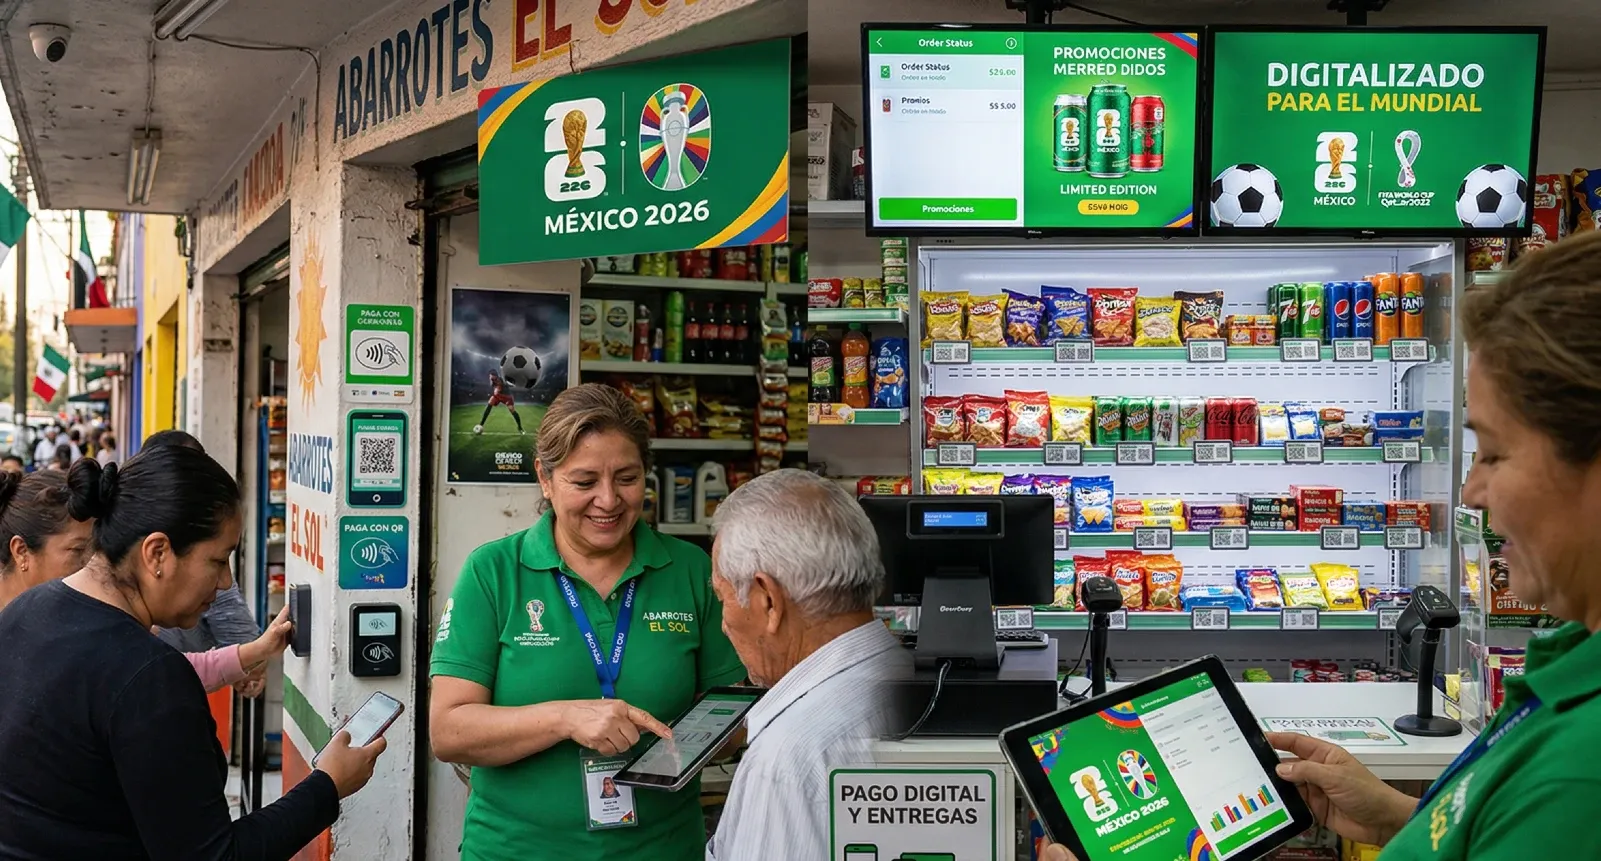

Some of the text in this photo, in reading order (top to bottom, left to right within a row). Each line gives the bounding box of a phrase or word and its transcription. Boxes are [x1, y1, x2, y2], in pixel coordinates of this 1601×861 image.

[918, 38, 973, 48] Order Status
[1053, 46, 1166, 60] PROMOCIONES
[333, 0, 494, 144] ABARROTES
[901, 62, 924, 71] Order
[1053, 63, 1166, 76] MERRED DIDOS
[1267, 62, 1485, 88] DIGITALIZADO
[1267, 92, 1482, 112] PARA EL MUNDIAL
[1060, 184, 1157, 195] LIMITED EDITION
[1313, 194, 1356, 206] MÉXICO
[921, 203, 975, 213] Promociones
[544, 199, 710, 236] MÉXICO 2026
[360, 309, 400, 318] PAGA CON
[344, 523, 404, 533] PAGA CON QR
[291, 503, 324, 572] EL SOL
[643, 611, 694, 622] ABARROTES
[649, 621, 691, 633] EL SOL
[841, 785, 986, 802] PAGO DIGITAL
[848, 807, 978, 825] Y ENTREGAS
[1095, 810, 1141, 838] MÉXICO
[1140, 796, 1170, 817] 2026
